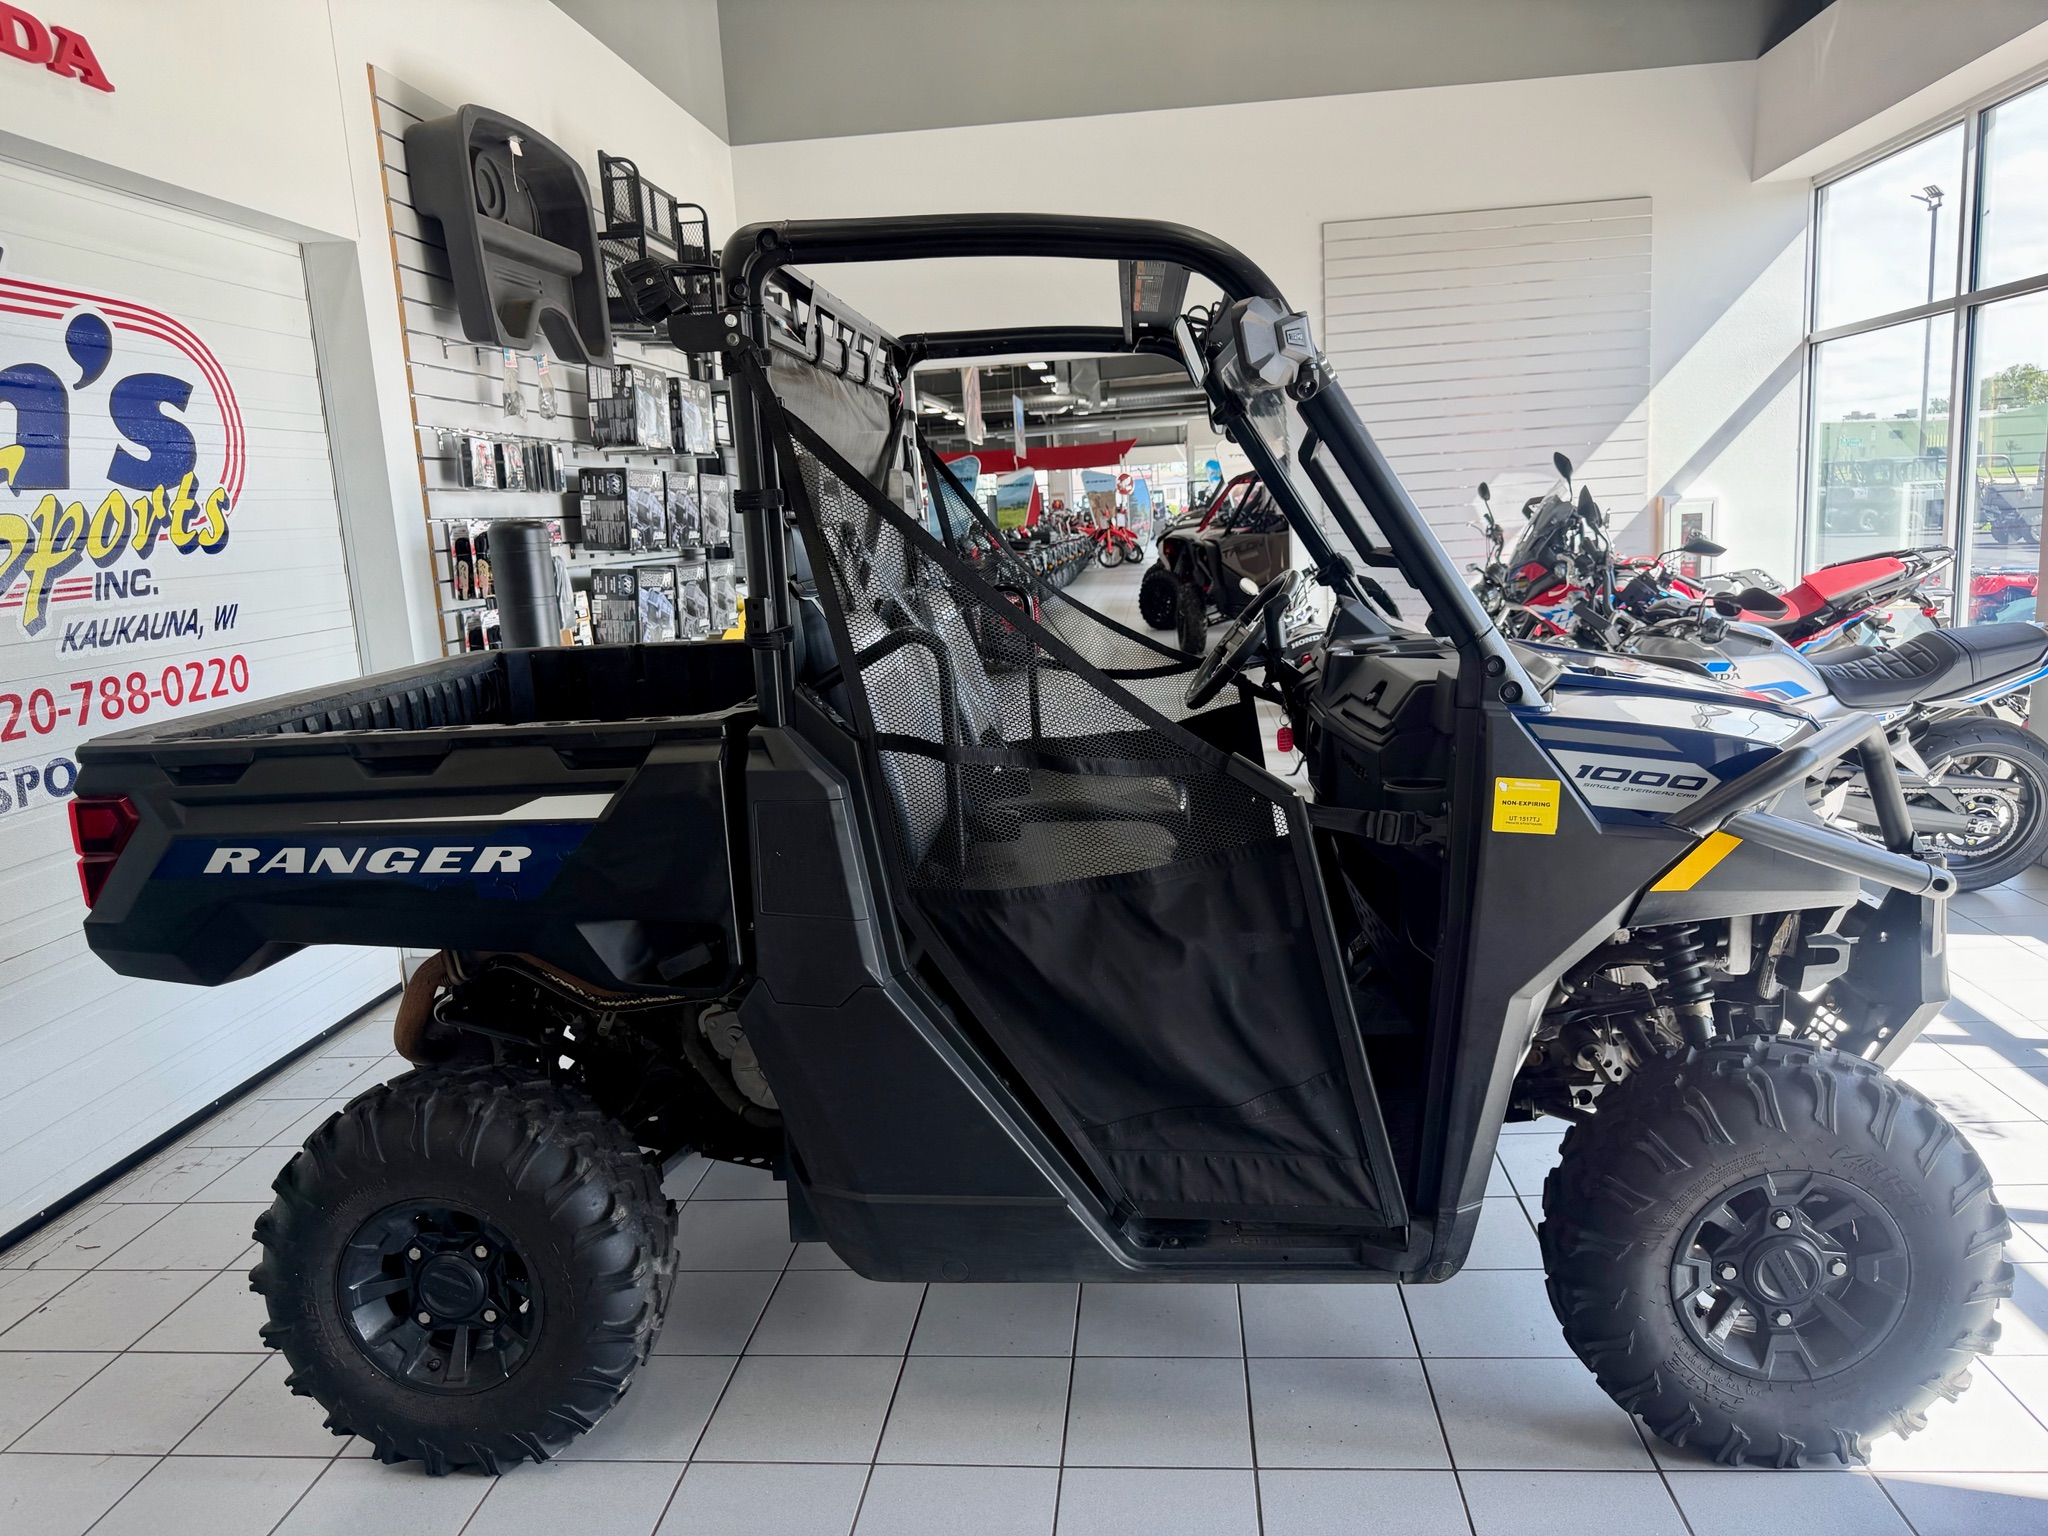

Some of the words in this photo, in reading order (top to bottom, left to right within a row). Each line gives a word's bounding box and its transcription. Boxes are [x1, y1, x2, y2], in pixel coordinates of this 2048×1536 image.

[96, 569, 159, 600] INC.
[61, 608, 204, 653] KAUKAUNA,
[214, 603, 239, 631] WI
[1291, 634, 1323, 649] HOND
[1574, 764, 1708, 791] 1000
[1583, 782, 1620, 791] SINGLE
[1623, 786, 1675, 797] OVERHEAD
[1502, 800, 1551, 808] NON-EXPIRING
[203, 846, 533, 874] RANGER
